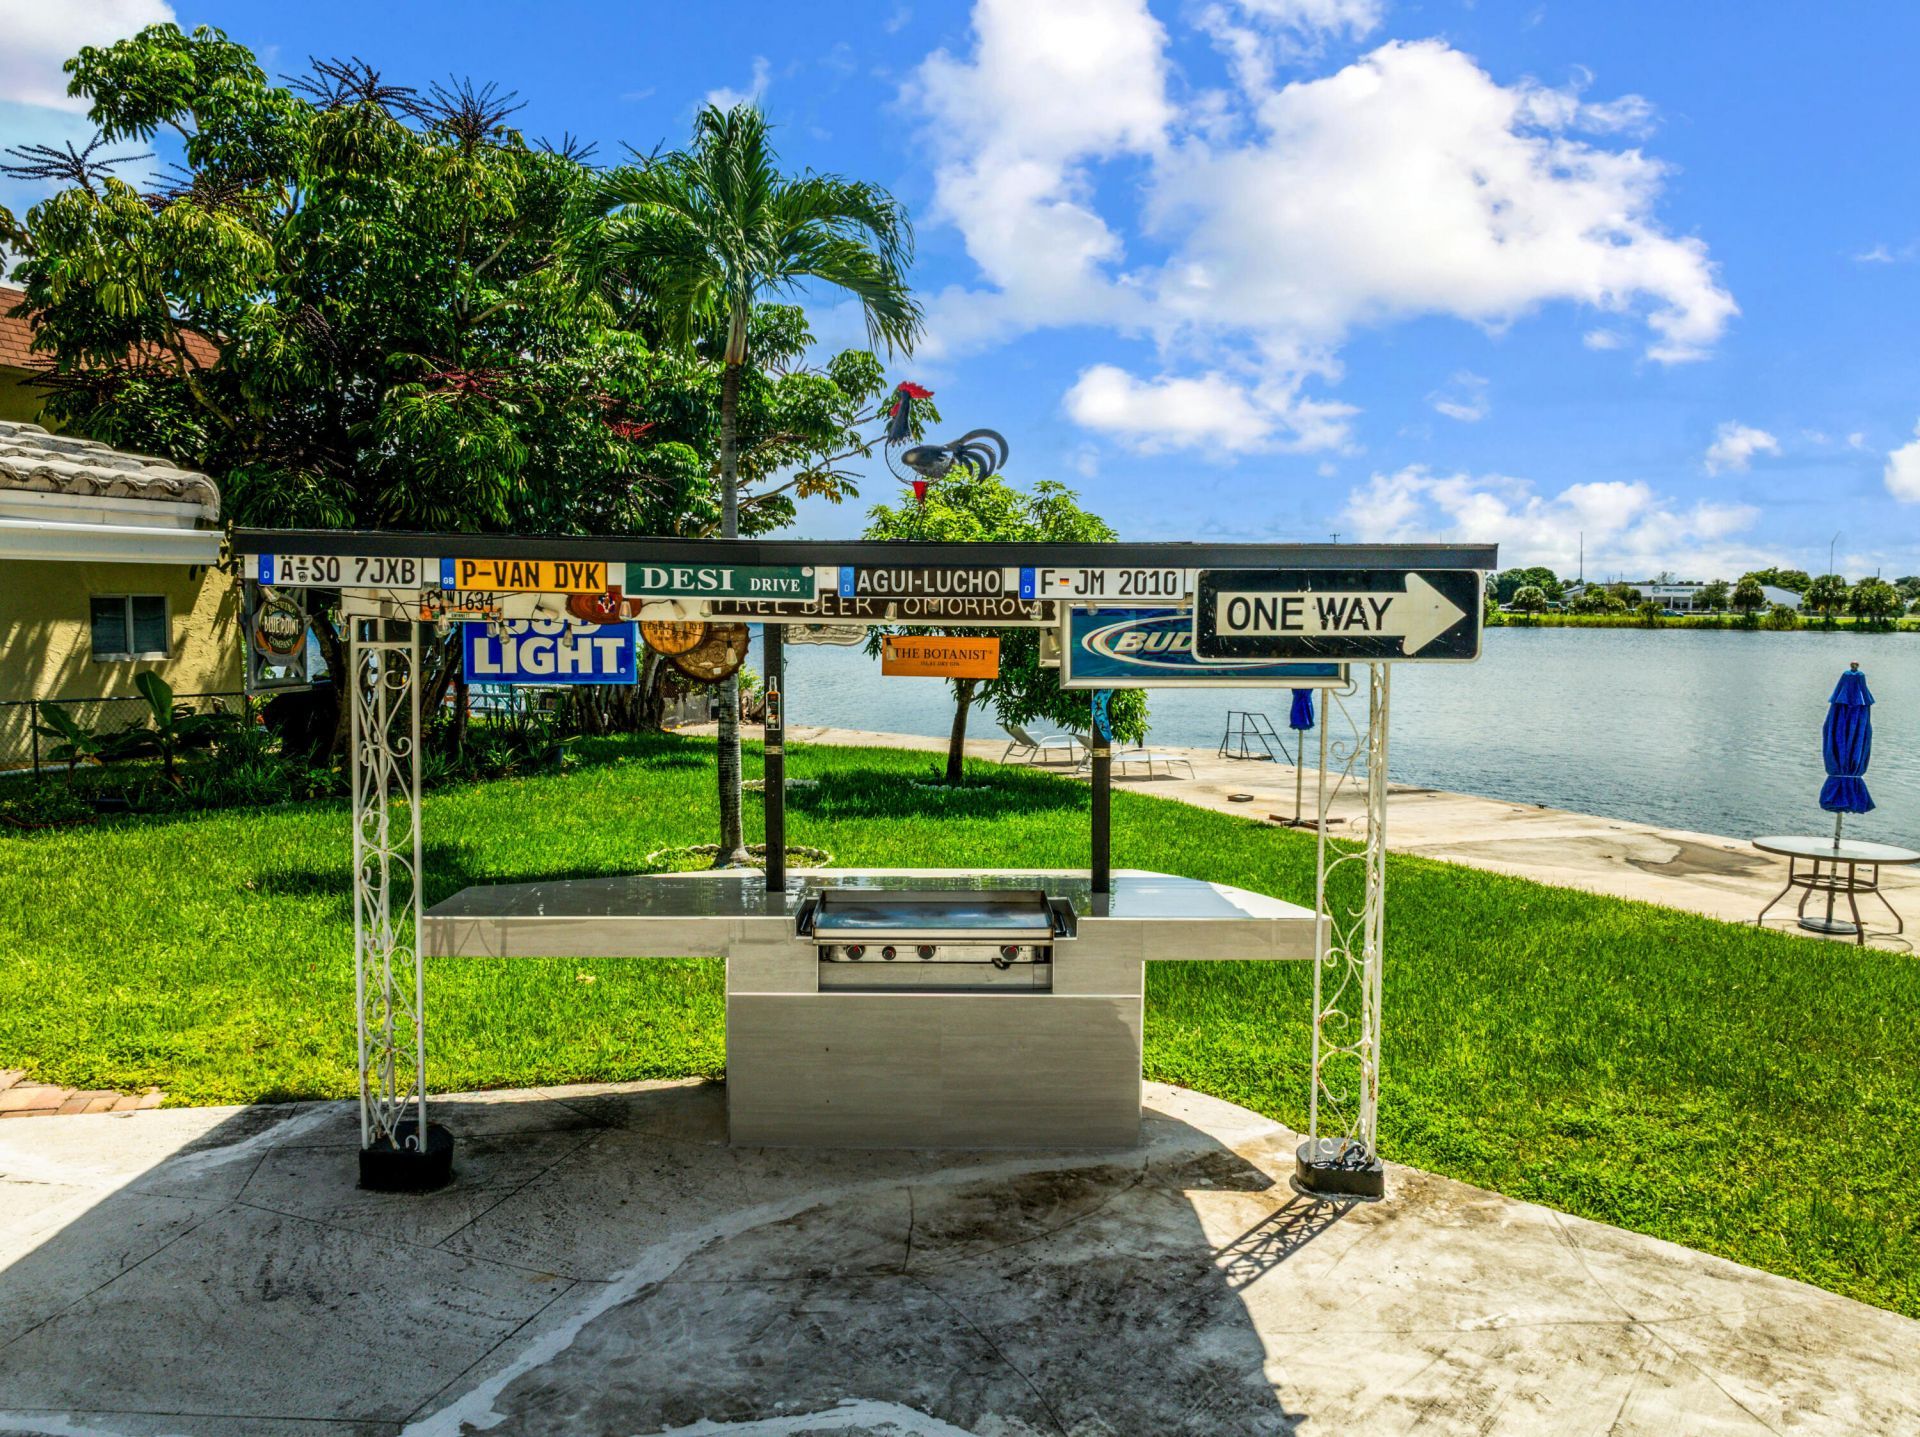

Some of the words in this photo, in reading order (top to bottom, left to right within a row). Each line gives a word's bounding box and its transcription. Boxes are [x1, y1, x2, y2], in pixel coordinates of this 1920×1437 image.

[263, 570, 270, 579] D
[355, 557, 415, 585] 7JXB
[443, 576, 454, 585] GB
[462, 560, 540, 588] P-VAN
[554, 562, 600, 591] DYK
[641, 567, 735, 591] DESI
[750, 578, 801, 592] DRIVE
[856, 569, 1001, 593] AGUI-LUCHO
[1118, 569, 1177, 595] 2010
[844, 584, 850, 592] D
[1024, 585, 1031, 593] D
[800, 593, 873, 615] BEER
[1226, 596, 1305, 631] ONE
[1316, 596, 1394, 631] WAY
[894, 647, 920, 659] THE
[924, 648, 988, 660] BOTANIST
[1113, 631, 1192, 653] BUD
[473, 636, 626, 675] LIGHT
